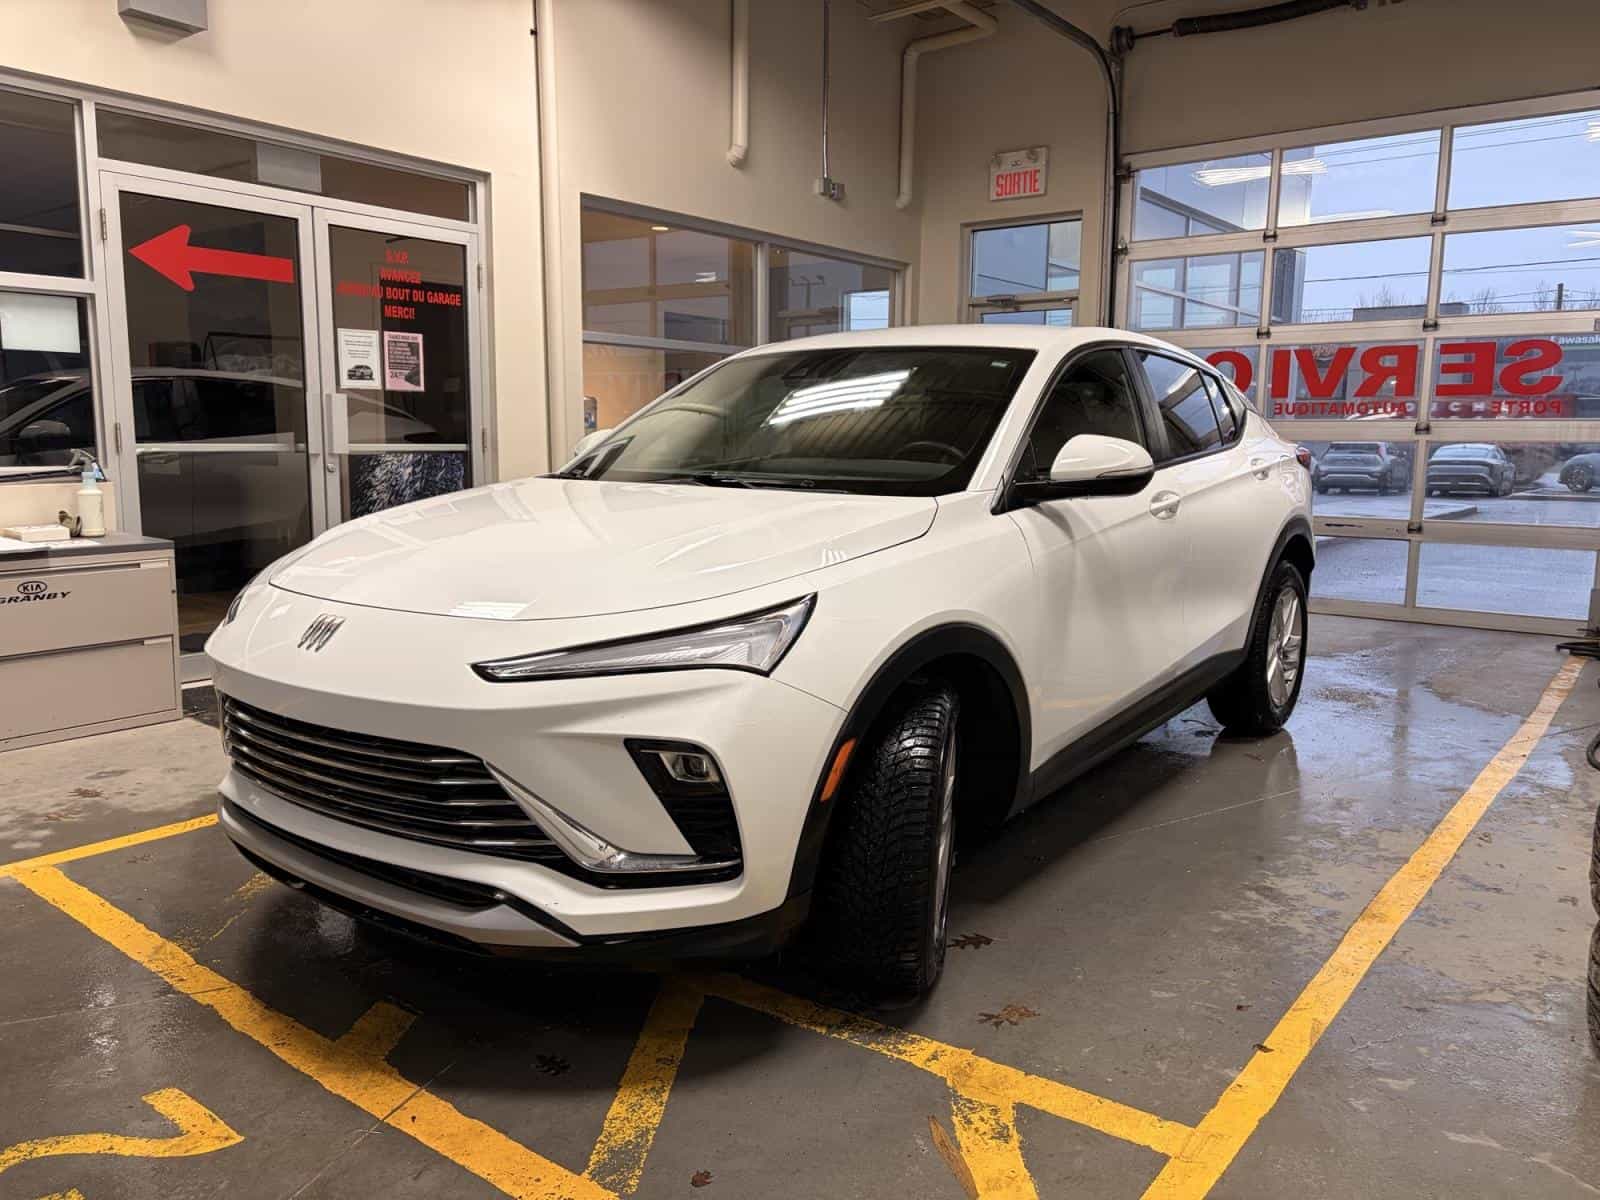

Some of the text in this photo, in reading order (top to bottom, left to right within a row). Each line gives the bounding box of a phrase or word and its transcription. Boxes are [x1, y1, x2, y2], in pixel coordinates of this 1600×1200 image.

[995, 169, 1040, 196] SORTIE
[386, 286, 411, 301] BOUT
[412, 289, 425, 303] DU
[427, 292, 462, 306] GARAGE
